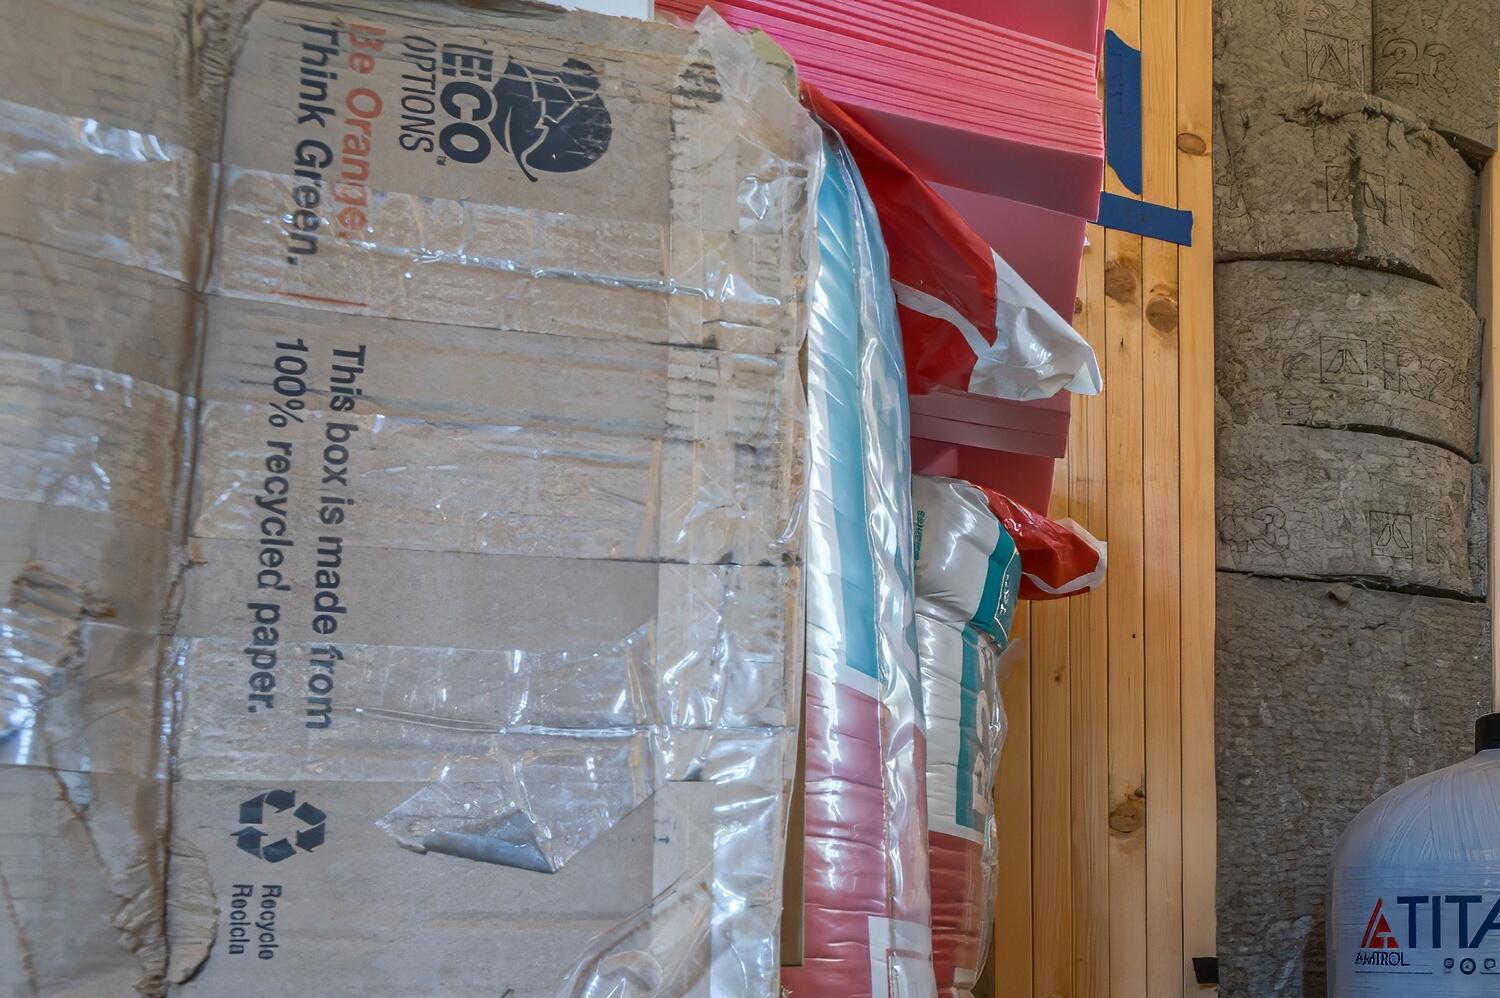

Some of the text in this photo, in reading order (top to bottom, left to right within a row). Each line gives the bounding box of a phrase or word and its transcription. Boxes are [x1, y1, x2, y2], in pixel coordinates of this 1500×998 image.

[347, 23, 387, 75] Be
[399, 35, 438, 153] OPTIONS
[287, 23, 341, 266] Think Green.
[244, 338, 310, 714] 100% recycled paper.
[305, 344, 367, 730] This box is made from
[229, 884, 254, 955] Recicla
[255, 885, 283, 961] Recycle
[1354, 951, 1411, 967] AMTROL
